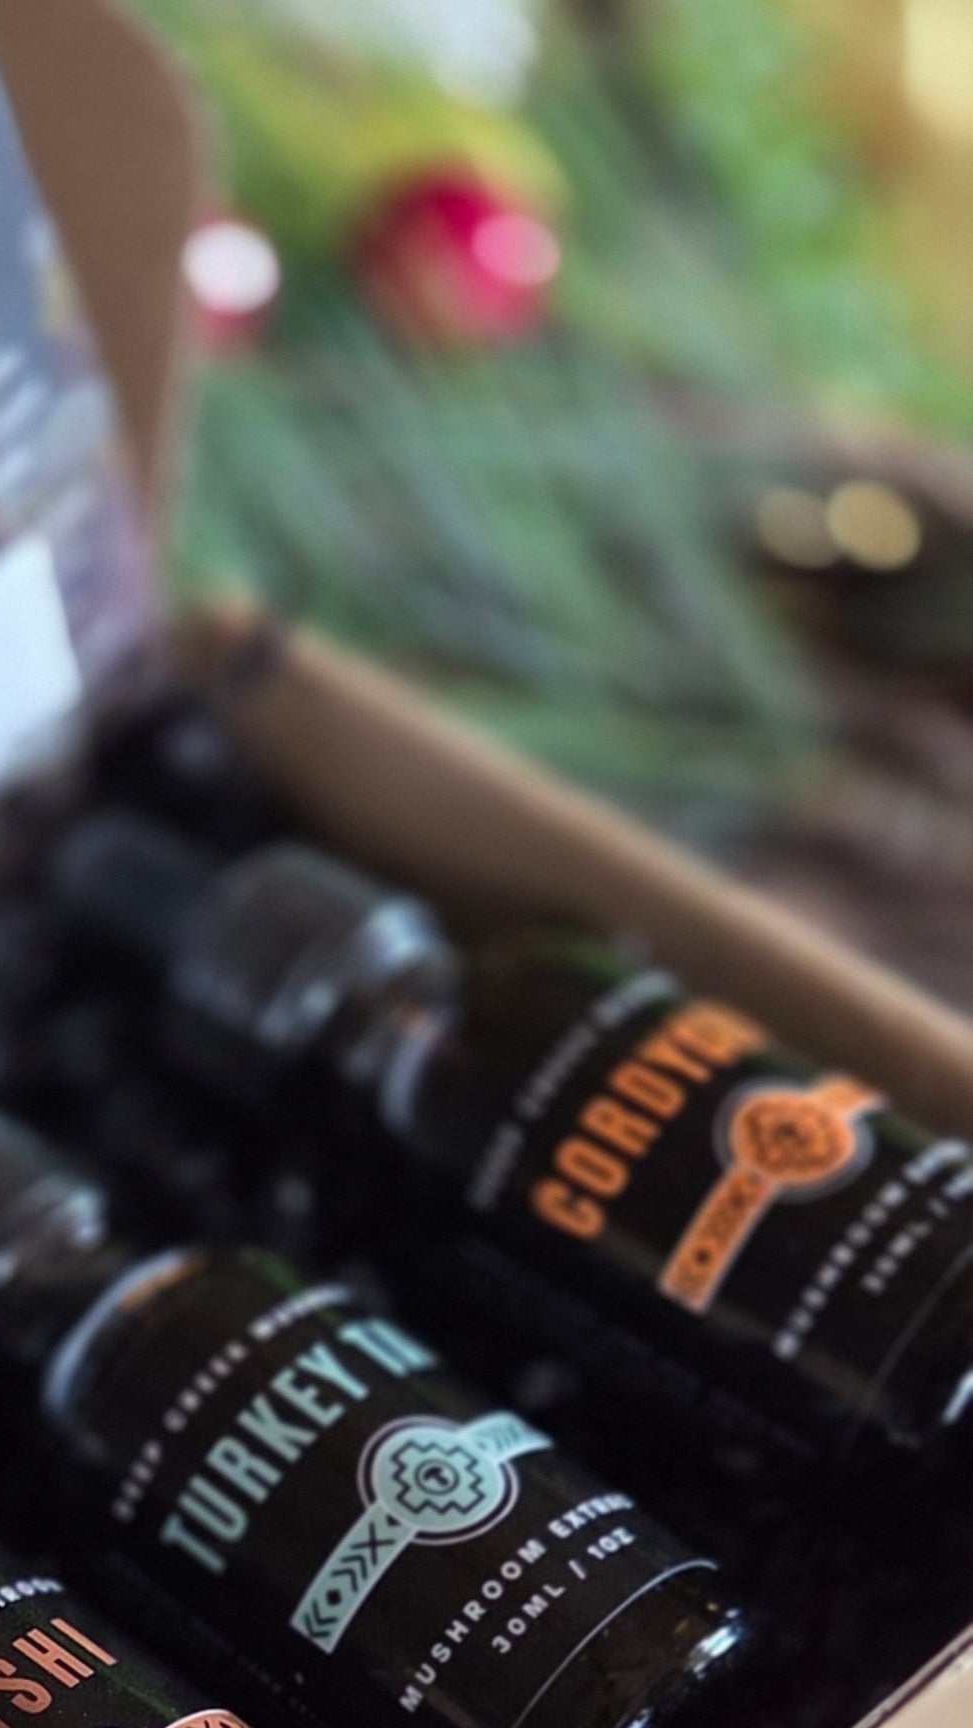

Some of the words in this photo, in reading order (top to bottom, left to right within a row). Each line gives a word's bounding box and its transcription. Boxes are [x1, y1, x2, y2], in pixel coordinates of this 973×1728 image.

[161, 1342, 370, 1574] TURKEY
[398, 1539, 546, 1714] MUSHROOM
[491, 1584, 565, 1656] 30ML
[587, 1526, 635, 1559] 1OZ
